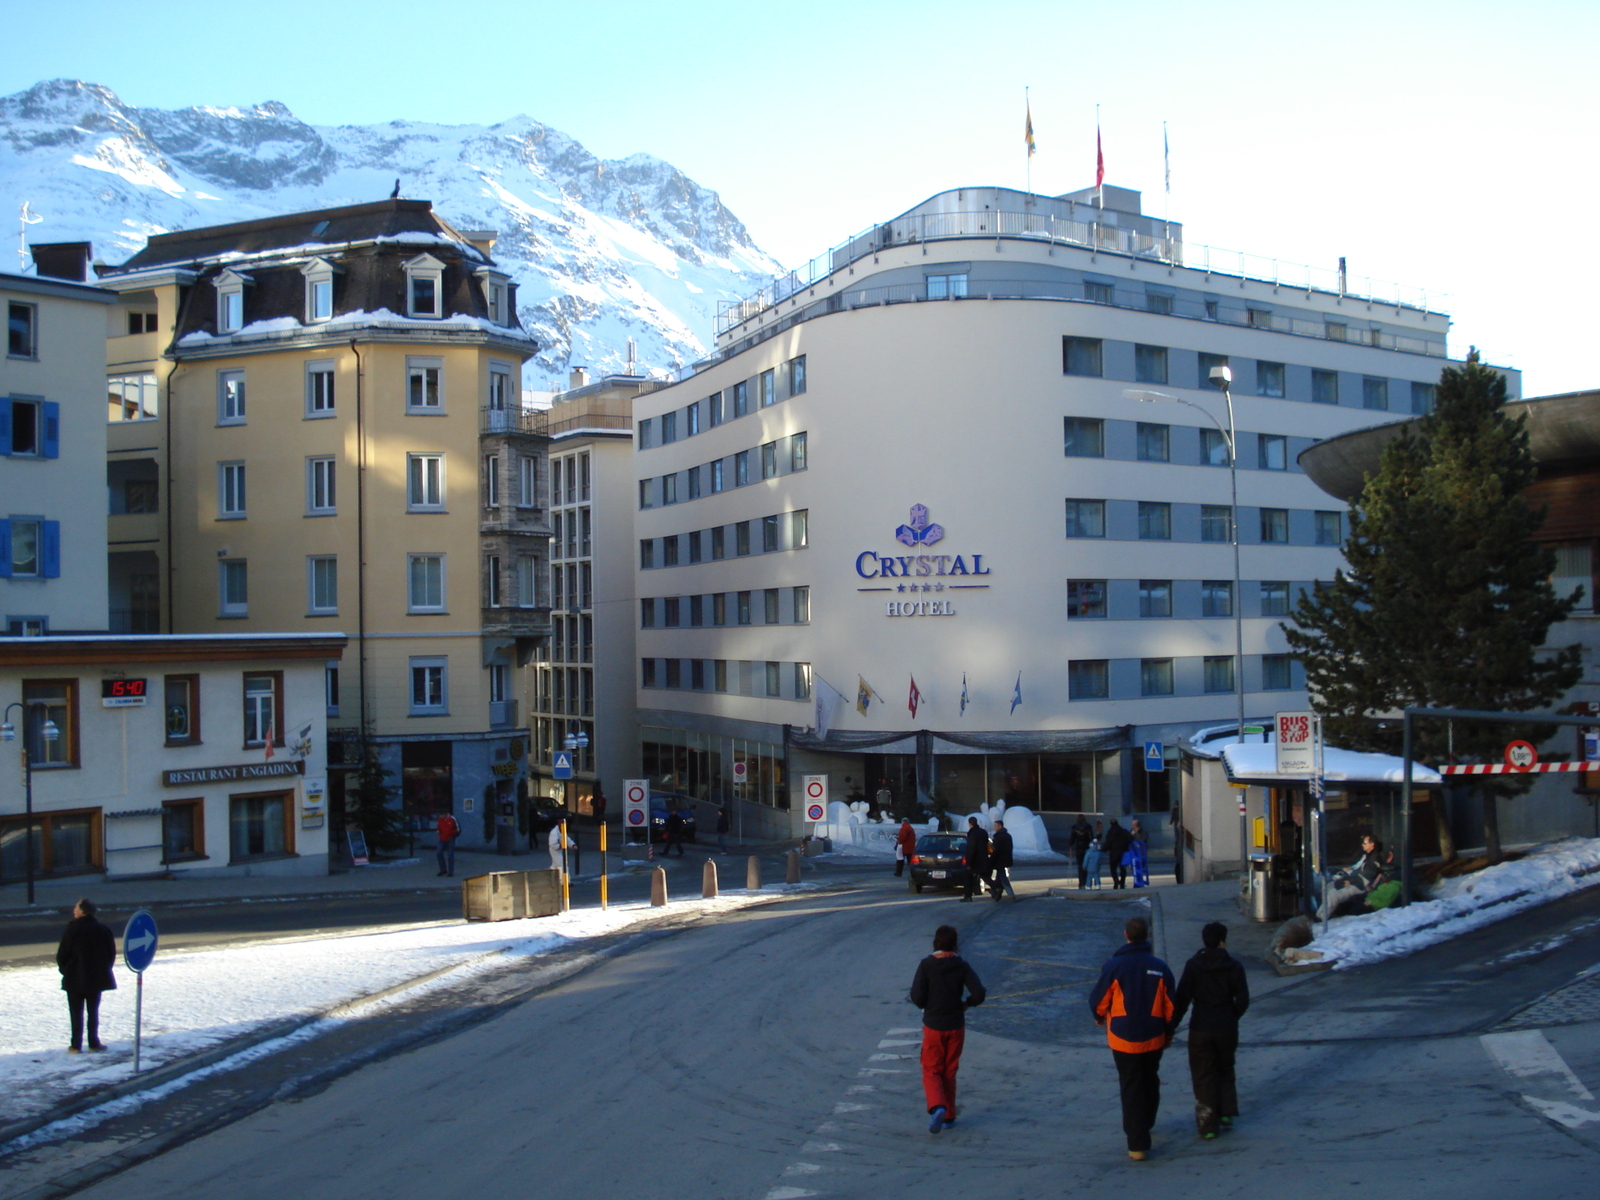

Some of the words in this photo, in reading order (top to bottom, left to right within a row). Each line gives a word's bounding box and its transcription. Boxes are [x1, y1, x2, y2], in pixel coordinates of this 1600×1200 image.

[855, 551, 990, 578] CRYSTAL
[886, 601, 955, 617] HOTEL
[1280, 716, 1308, 731] BUS
[1281, 731, 1308, 743] STOP
[169, 769, 238, 783] RESTAURANT
[242, 763, 298, 777] ENGIADINA
